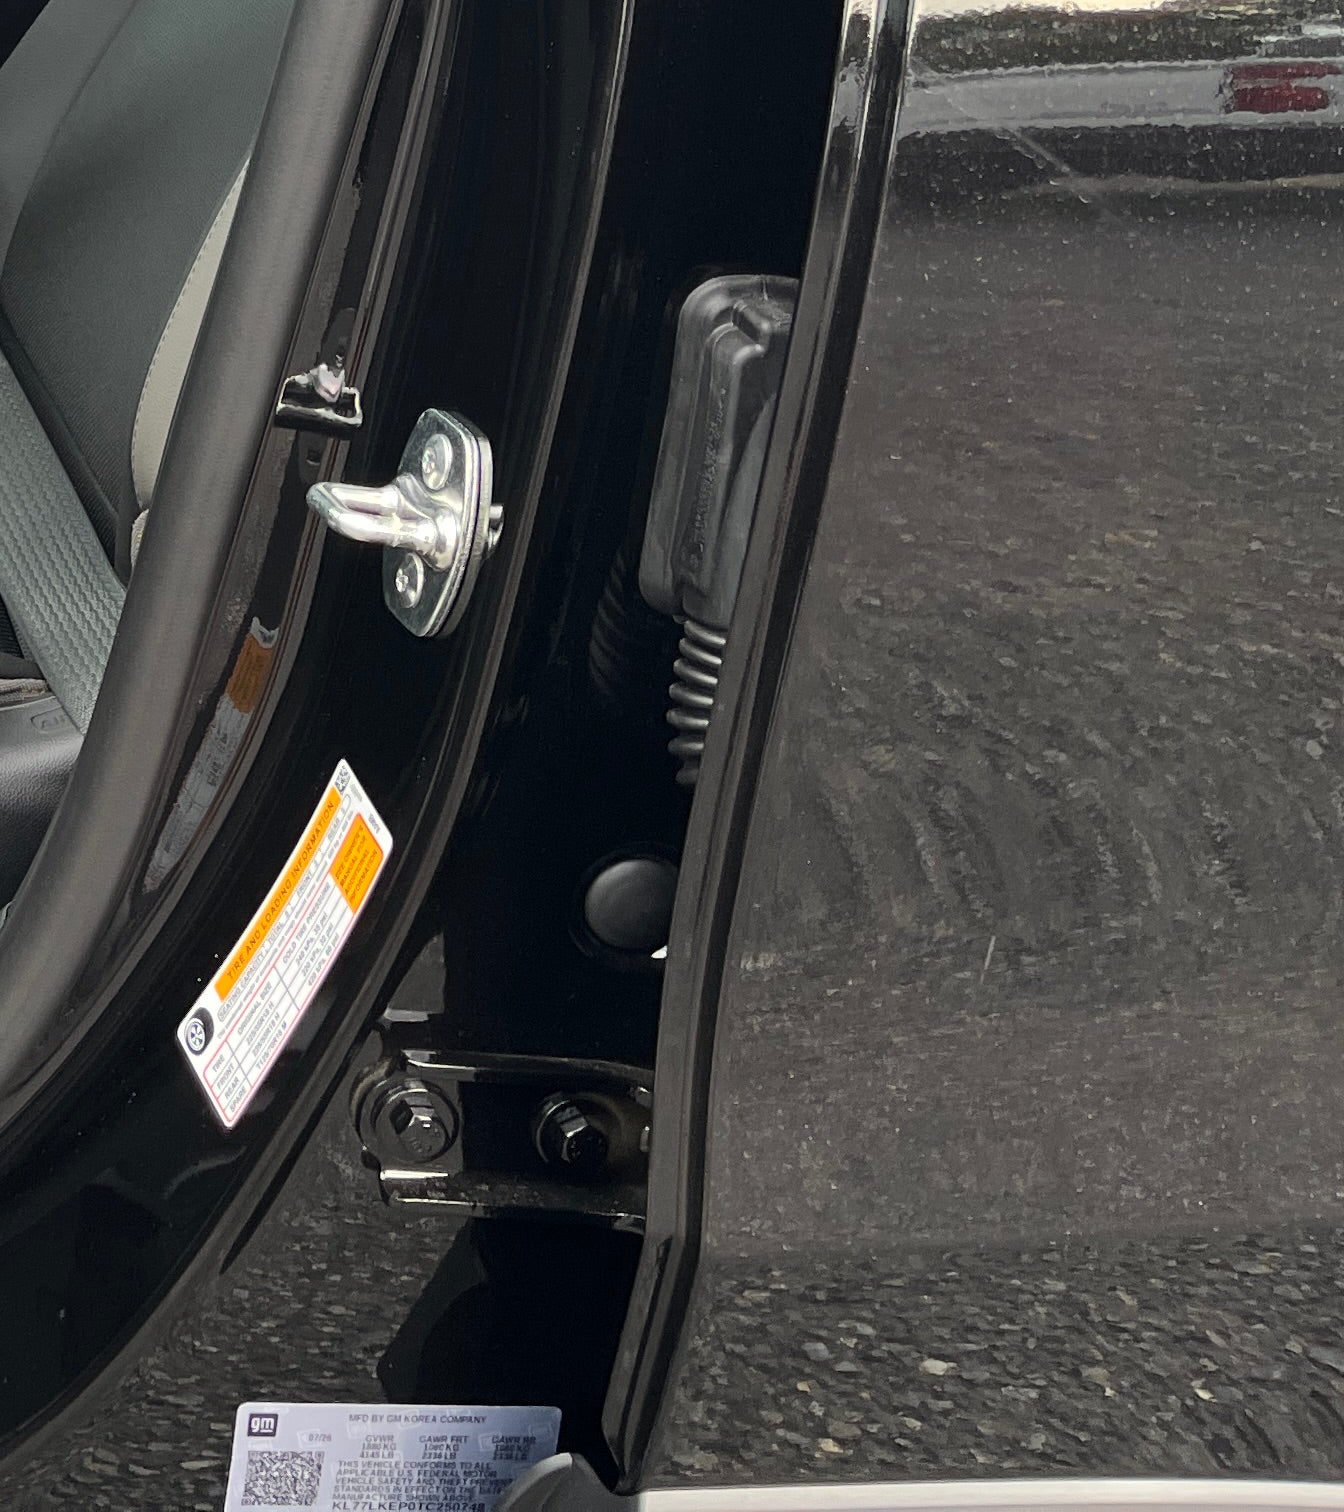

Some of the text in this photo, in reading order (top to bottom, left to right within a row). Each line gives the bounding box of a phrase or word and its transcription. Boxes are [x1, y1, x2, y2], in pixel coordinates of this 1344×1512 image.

[227, 951, 245, 980] TIRE
[245, 928, 260, 953] AND
[261, 878, 292, 930] LOADING
[291, 800, 333, 878] INFORMATION
[349, 1414, 487, 1424] MFD BY GM KOREA COMPANY
[250, 1417, 275, 1433] gm
[362, 1461, 400, 1469] VEHICLE
[336, 1469, 394, 1477] APPLICABLE
[336, 1477, 374, 1485] VEHICLE
